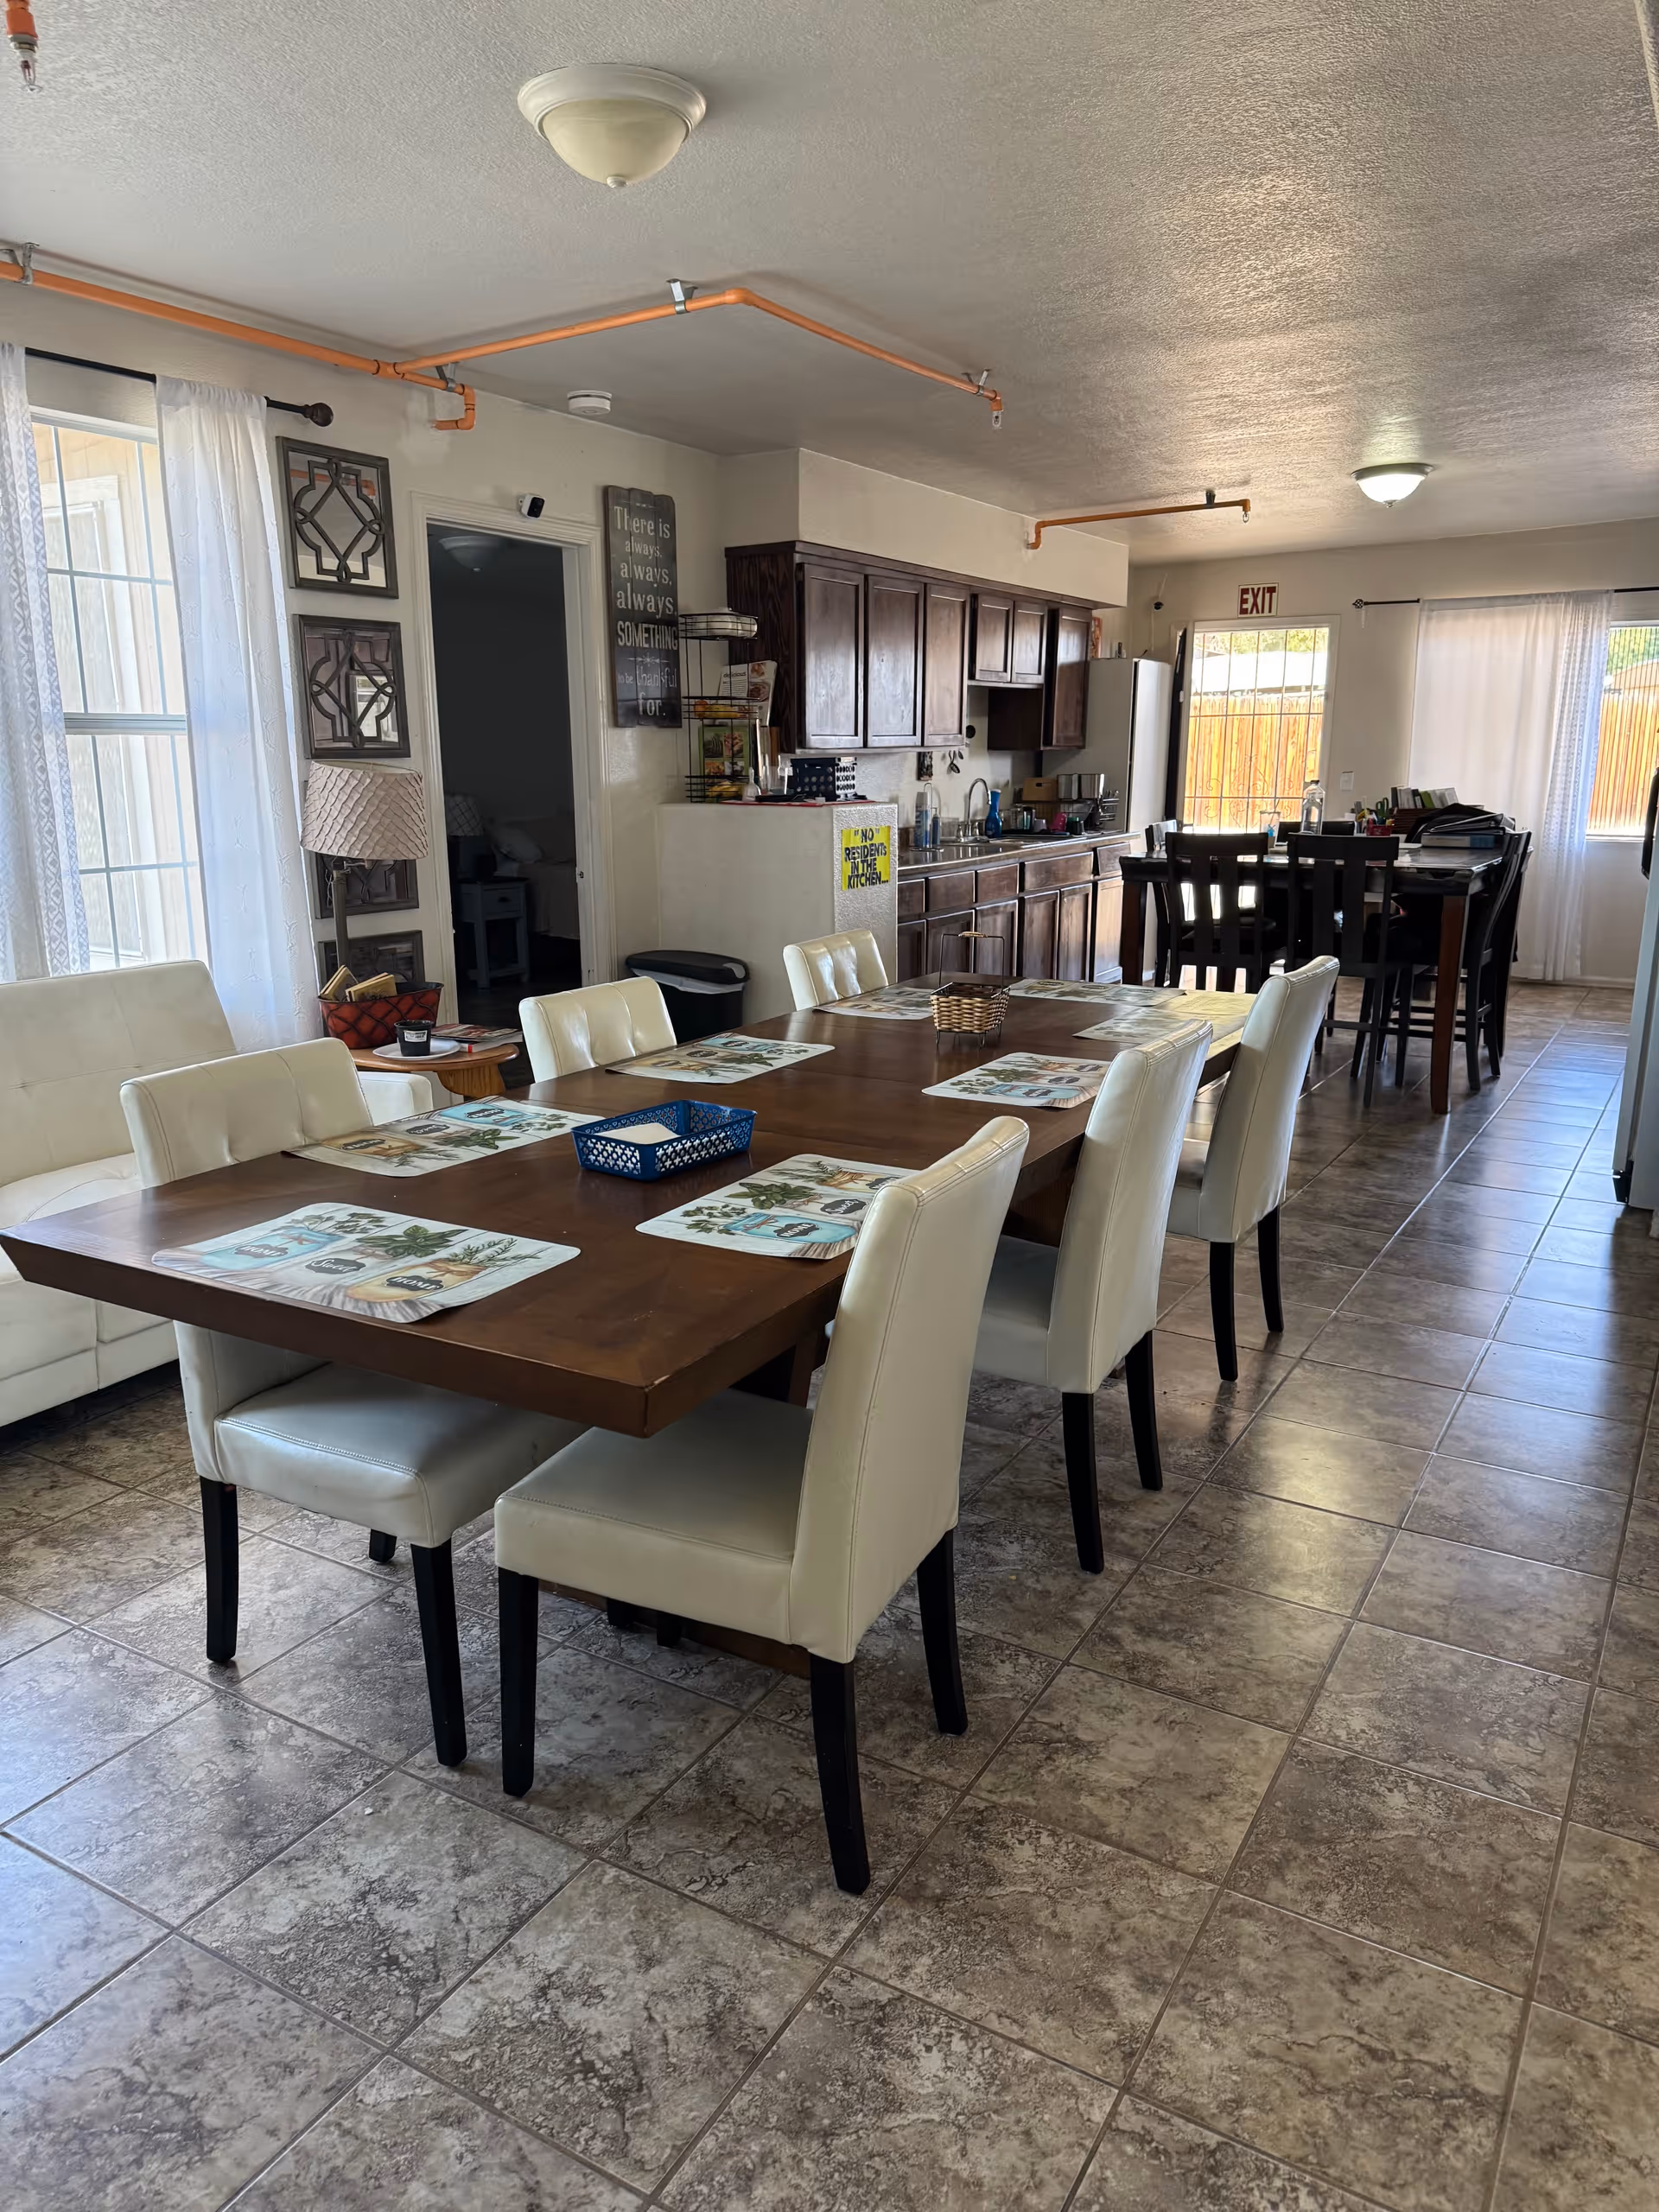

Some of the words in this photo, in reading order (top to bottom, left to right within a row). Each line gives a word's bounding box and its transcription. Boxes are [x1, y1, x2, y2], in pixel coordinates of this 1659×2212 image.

[614, 505, 655, 536] There
[658, 518, 671, 539] is
[1239, 586, 1276, 615] EXIT
[617, 620, 678, 651] SOMETHING
[626, 672, 634, 684] be
[636, 664, 677, 688] thankful
[851, 860, 859, 874] IN
[861, 857, 877, 873] THE
[312, 1259, 357, 1273] Sweet
